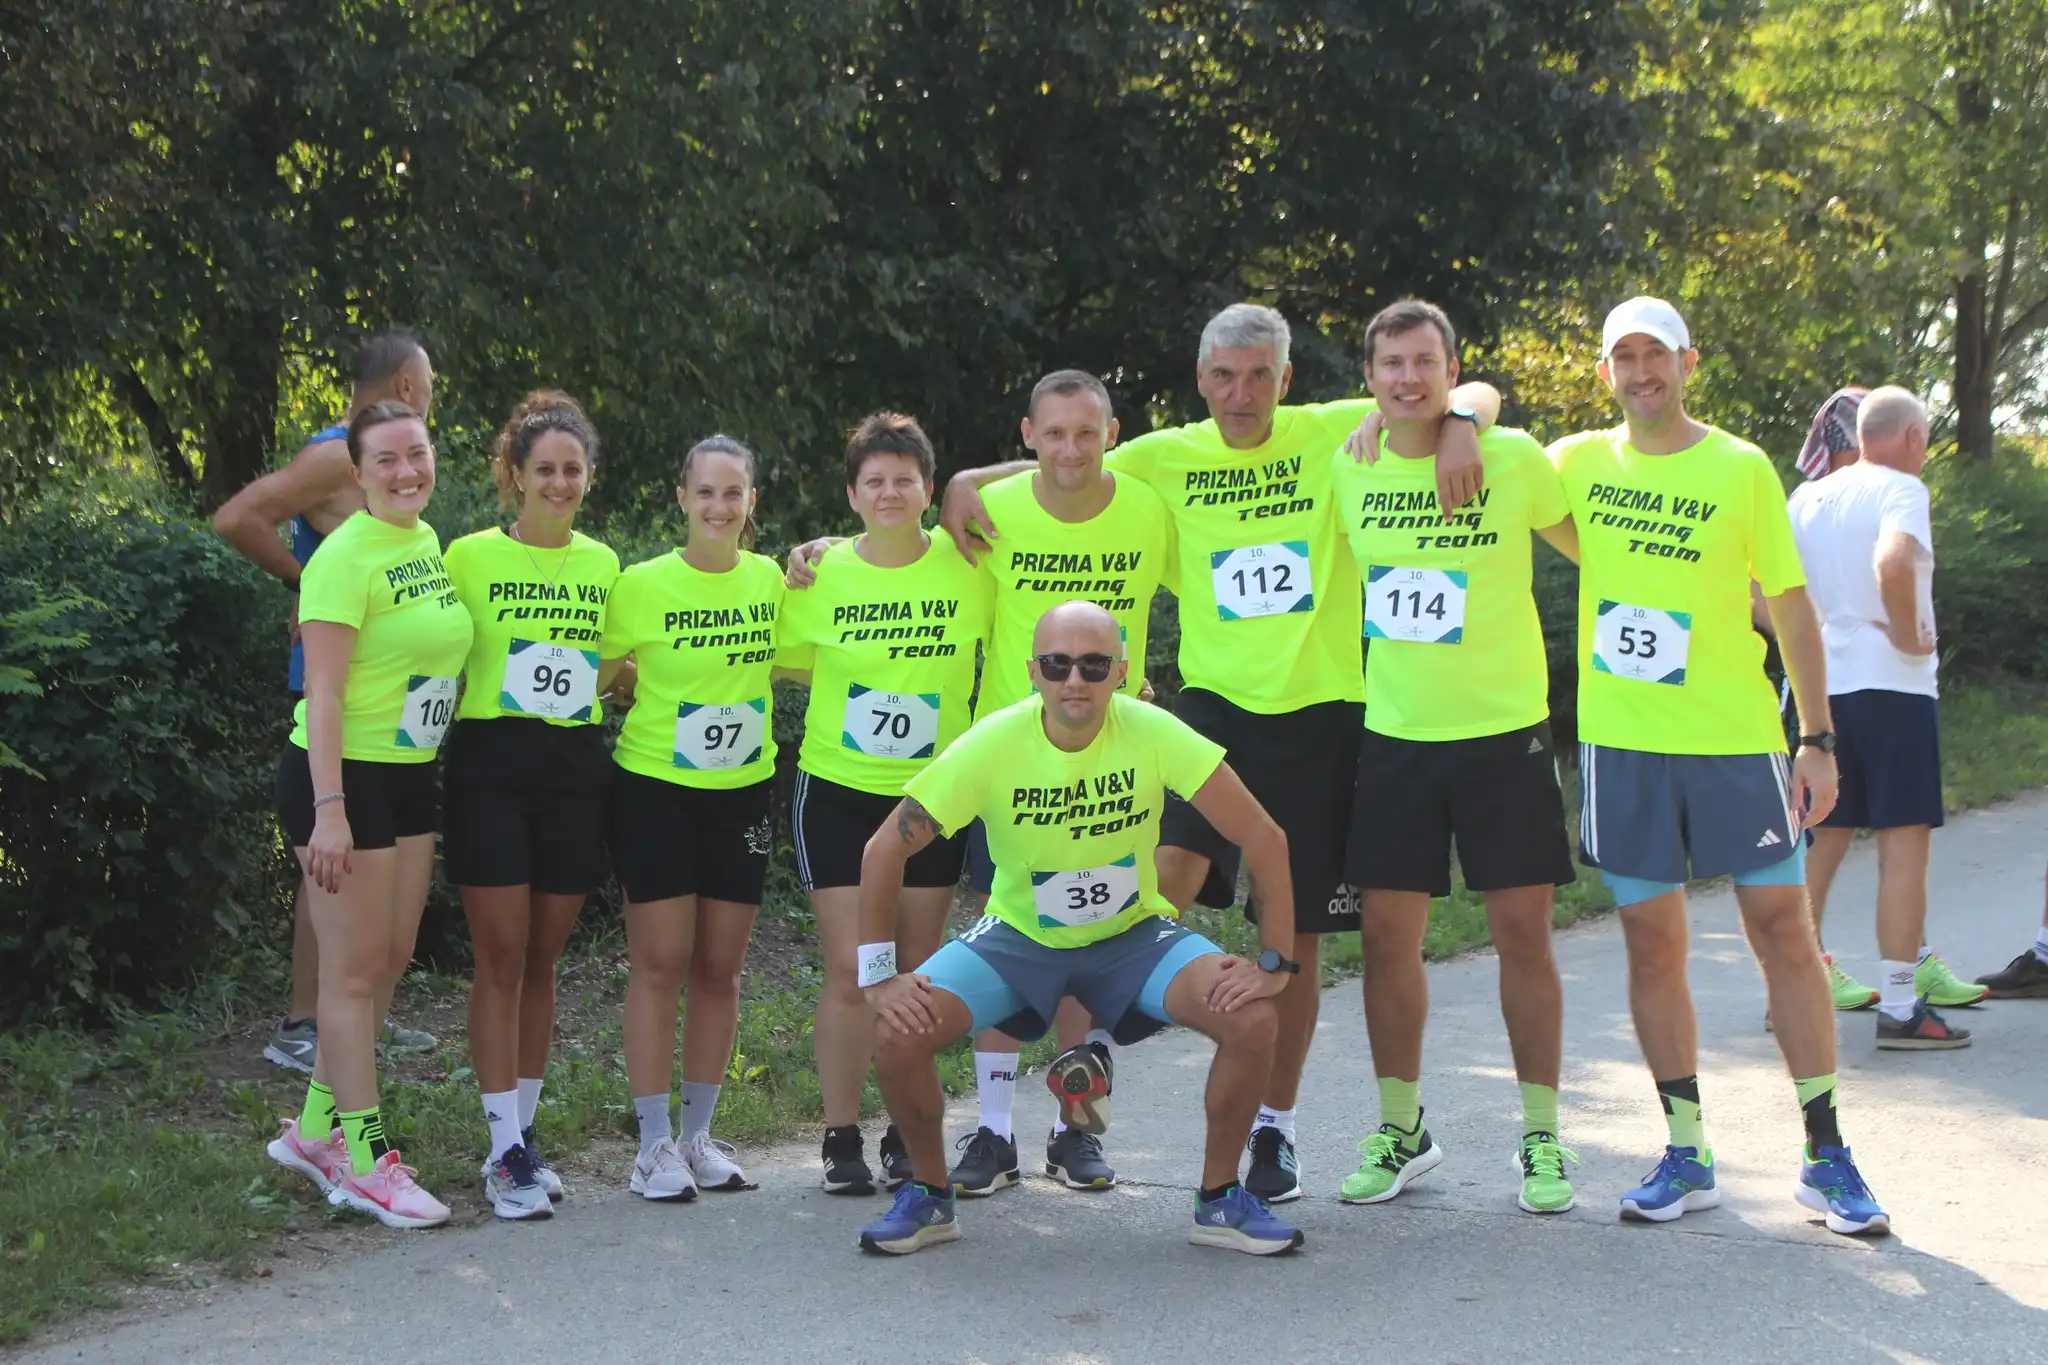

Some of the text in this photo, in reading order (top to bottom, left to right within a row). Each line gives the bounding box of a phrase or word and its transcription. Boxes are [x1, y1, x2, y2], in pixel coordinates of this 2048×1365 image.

[1186, 455, 1302, 491] PRIZMA V&V
[1184, 480, 1298, 507] running
[1362, 490, 1437, 512] PRIZMA
[1587, 483, 1717, 522] PRIZMA V&V
[1360, 512, 1483, 531] running
[1589, 511, 1694, 543] running
[385, 558, 433, 588] PRIZMA
[1011, 551, 1142, 573] PRIZMA V&V
[394, 577, 450, 605] runnin
[489, 582, 607, 606] PRIZMA V&V
[1015, 578, 1126, 596] running
[1231, 564, 1293, 597] 112
[497, 607, 599, 627] running
[665, 602, 775, 632] PRIZMA V&V
[833, 599, 959, 626] PRIZMA V&V
[1387, 589, 1446, 620] 114
[673, 629, 771, 650] running
[839, 625, 946, 643] running
[1618, 626, 1657, 659] 53
[533, 665, 572, 696] 96
[420, 698, 452, 727] 108
[871, 709, 911, 739] 70
[704, 722, 743, 750] 97
[1012, 768, 1135, 808] PRIZMA V&V
[1013, 795, 1134, 825] running
[1066, 882, 1111, 910] 38
